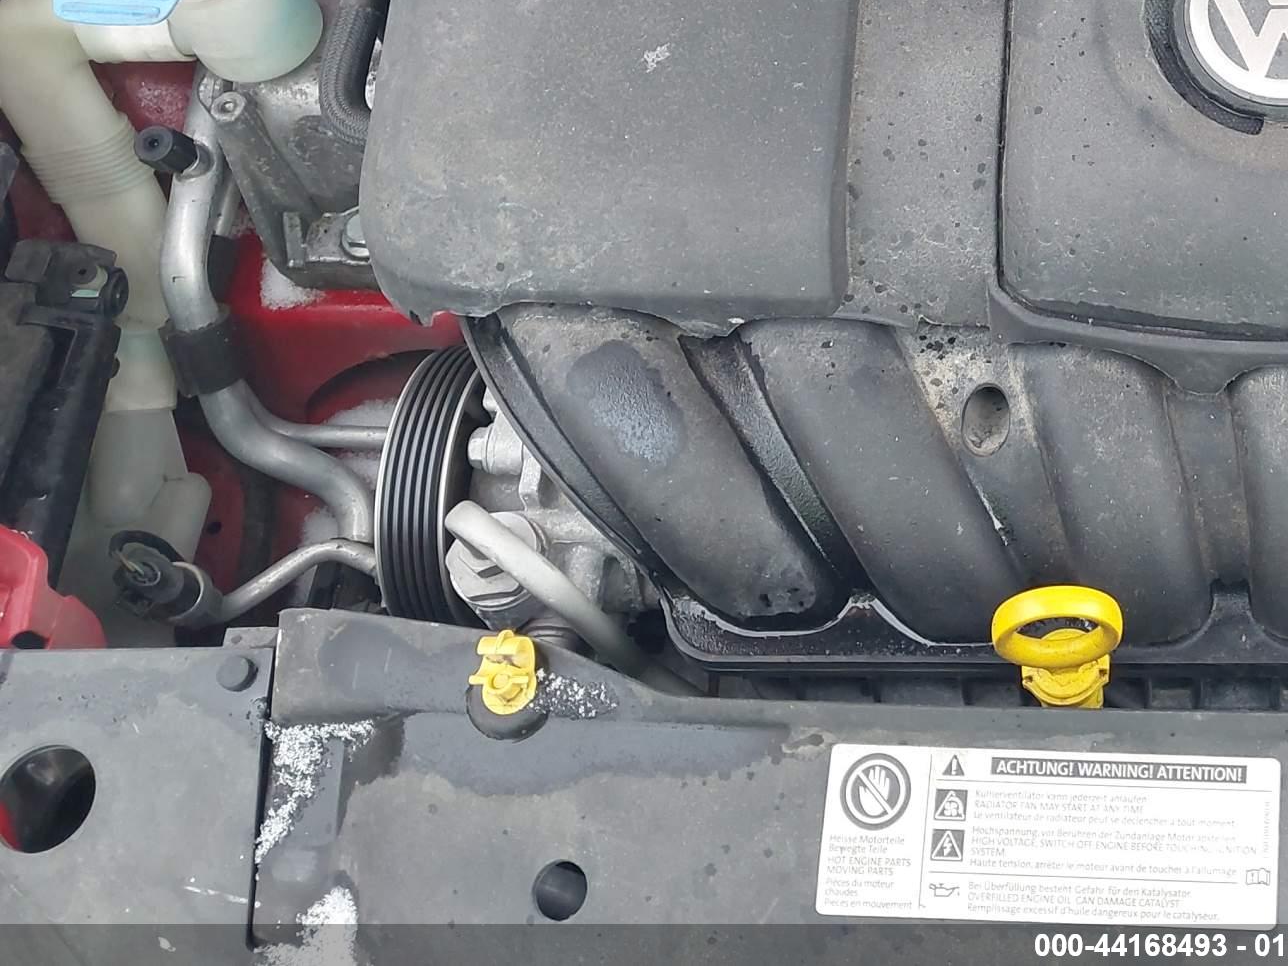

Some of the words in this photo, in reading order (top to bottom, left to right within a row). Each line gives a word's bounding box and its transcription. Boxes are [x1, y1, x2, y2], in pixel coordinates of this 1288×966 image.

[996, 759, 1074, 776] ACHTUNG!
[1077, 761, 1154, 779] WARNING!
[1157, 764, 1243, 782] ATTENTION!
[974, 799, 1017, 809] RADIATOR
[1019, 800, 1037, 810] FAN
[1039, 801, 1059, 811] MAY
[1061, 802, 1087, 812] START
[828, 834, 858, 844] Heisse
[859, 835, 905, 846] Motorteile
[970, 835, 994, 845] HIGH
[1039, 838, 1074, 848] SWITCH
[1076, 839, 1092, 849] OFF
[1094, 840, 1130, 851] ENGINE
[1130, 841, 1163, 852] BEFORE
[828, 843, 866, 855] Bewegte
[869, 845, 888, 854] Teile
[827, 855, 846, 864] HOT
[849, 856, 883, 867] ENGINE
[885, 858, 912, 867] PARTS
[969, 857, 997, 867] Haute
[1135, 863, 1147, 873] de
[826, 865, 865, 875] MOVING
[867, 866, 895, 876] PARTS
[851, 878, 862, 888] du
[863, 879, 895, 889] moteur
[967, 880, 982, 890] Bei
[1038, 882, 1071, 893] besteht
[1074, 884, 1104, 895] Gefahr
[1122, 885, 1139, 896] den
[824, 887, 858, 897] chaudes
[850, 899, 861, 908] en
[862, 900, 912, 909] mouvement
[967, 891, 1019, 903] OVERFILLED
[1019, 893, 1055, 904] ENGINE
[1056, 894, 1071, 904] OIL
[1074, 895, 1095, 905] CAN
[1096, 895, 1137, 907] DAMAGE
[1137, 897, 1181, 909] CATALYST
[967, 901, 1021, 916] Remplissage
[1022, 903, 1058, 915] excessif
[1090, 906, 1138, 920] dangereux
[1139, 910, 1161, 921] pour
[1162, 909, 1171, 919] le
